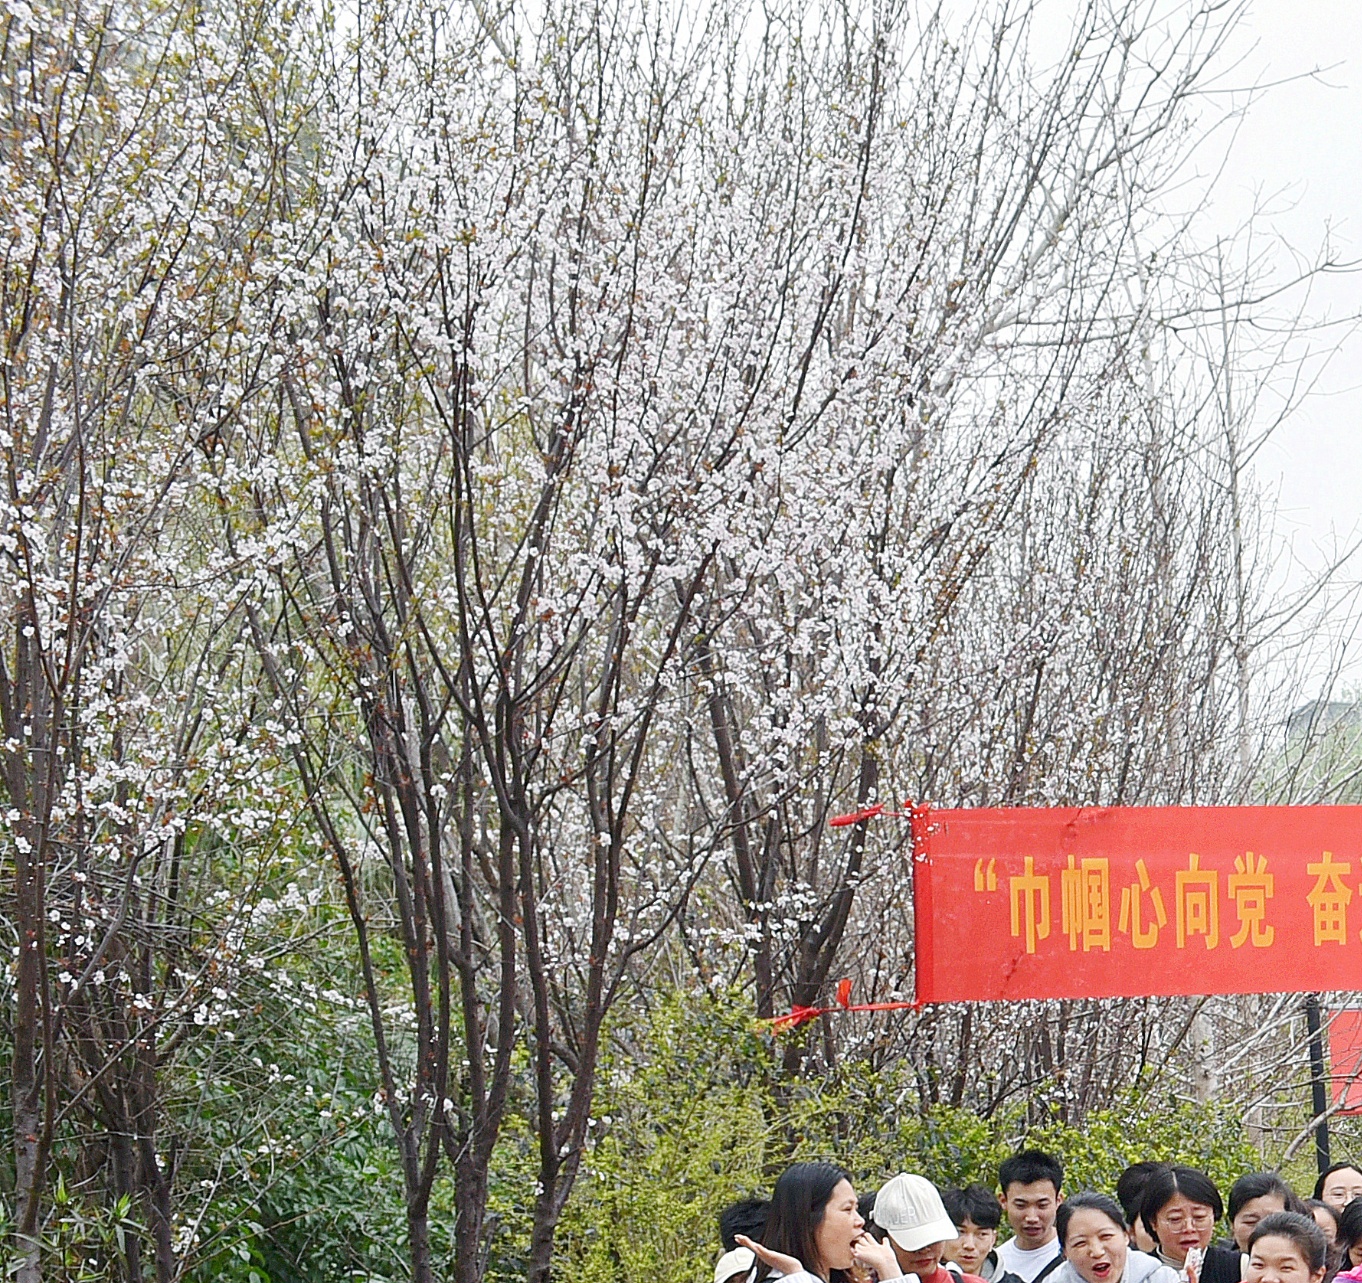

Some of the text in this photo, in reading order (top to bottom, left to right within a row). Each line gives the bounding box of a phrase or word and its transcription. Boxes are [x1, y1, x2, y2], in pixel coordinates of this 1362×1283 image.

[973, 850, 1275, 954] “巾帼心向党
